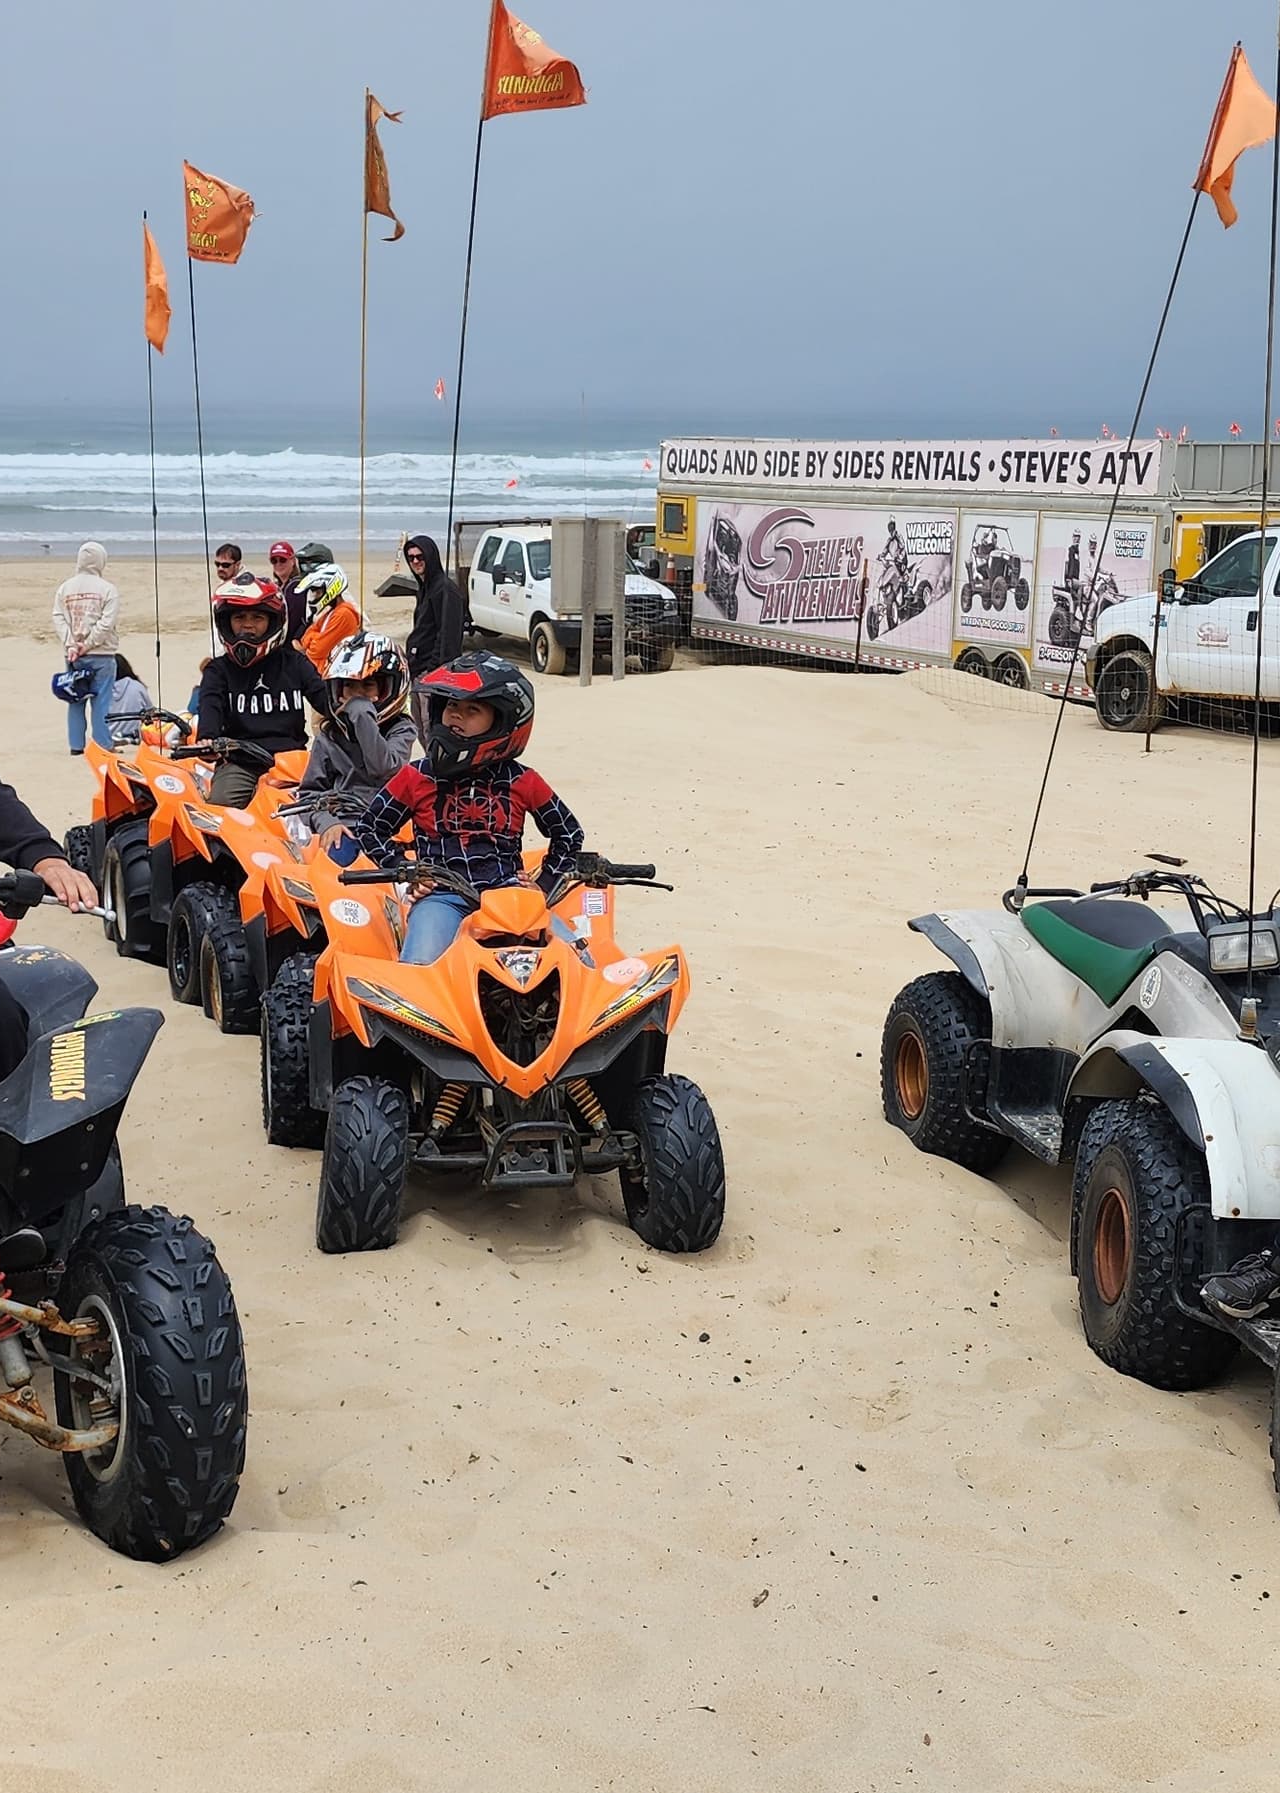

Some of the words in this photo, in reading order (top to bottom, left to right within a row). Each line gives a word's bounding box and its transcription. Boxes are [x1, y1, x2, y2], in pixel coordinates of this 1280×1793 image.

[666, 448, 718, 474] QUADS
[722, 449, 758, 475] AND
[762, 450, 800, 477] SIDE
[805, 450, 829, 478] BY
[832, 450, 885, 480] SIDES
[891, 450, 981, 482] RENTALS
[999, 451, 1092, 485] STEVE'S
[1098, 451, 1153, 485] ATV
[905, 537, 952, 556] WELCOME
[759, 582, 797, 623] ATV
[792, 576, 870, 623] RENTALS
